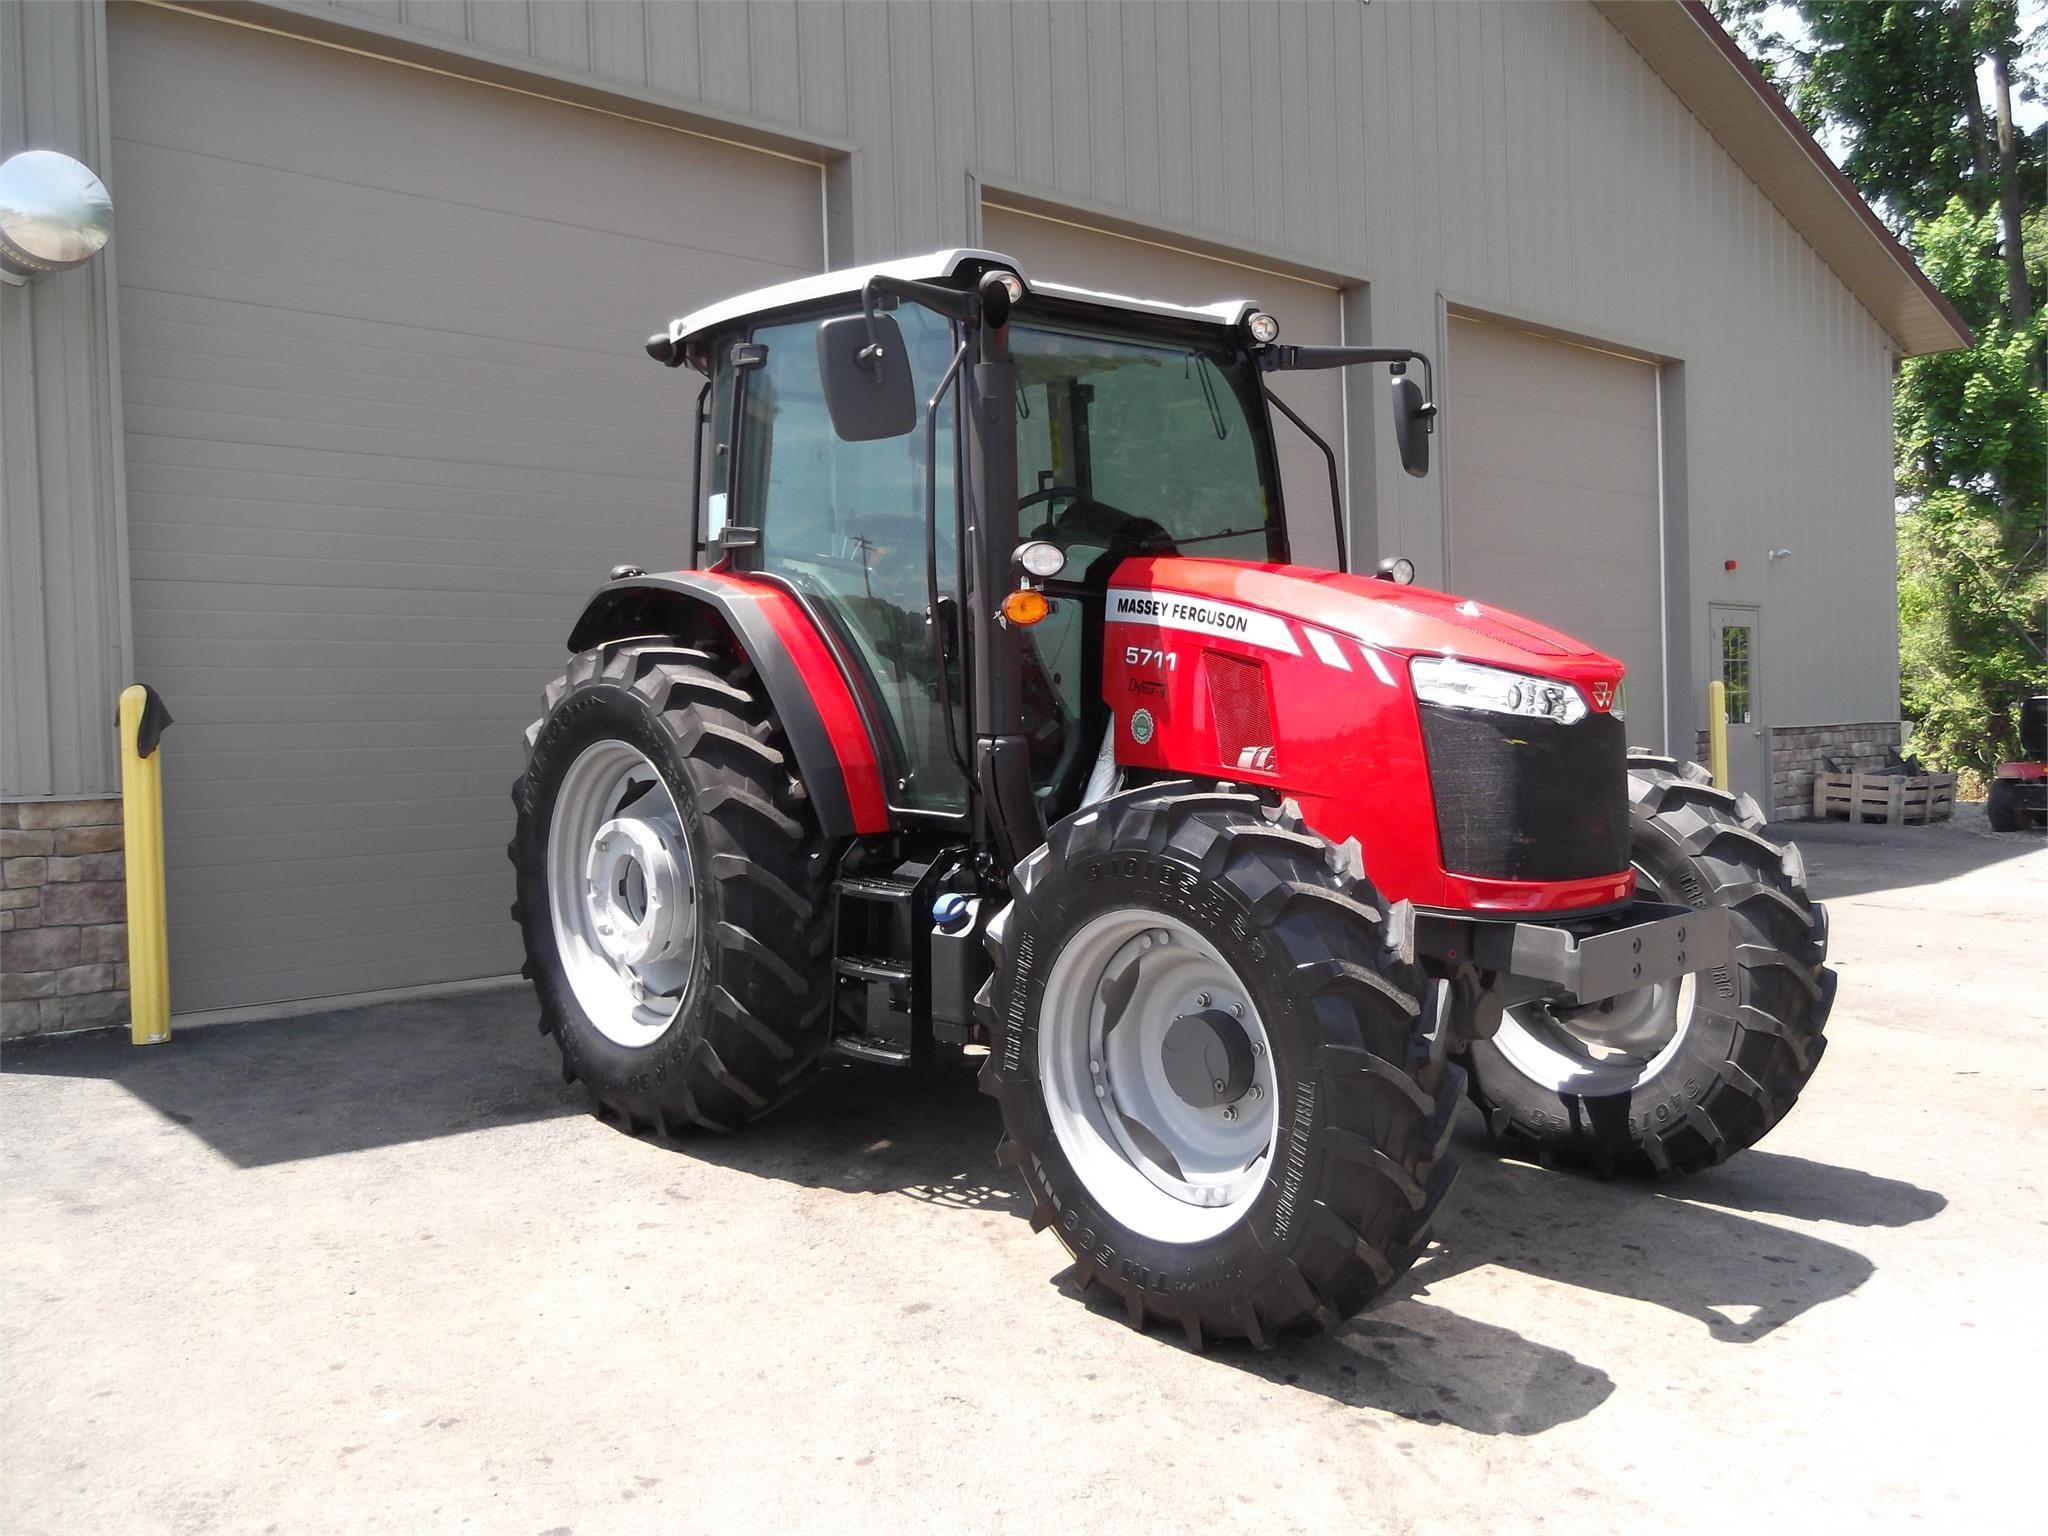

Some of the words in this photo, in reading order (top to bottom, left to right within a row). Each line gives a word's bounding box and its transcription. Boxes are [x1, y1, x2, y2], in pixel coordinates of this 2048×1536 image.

[1117, 597, 1169, 617] MASSEY
[1172, 604, 1248, 633] FERGUSON
[1125, 646, 1178, 672] 5711
